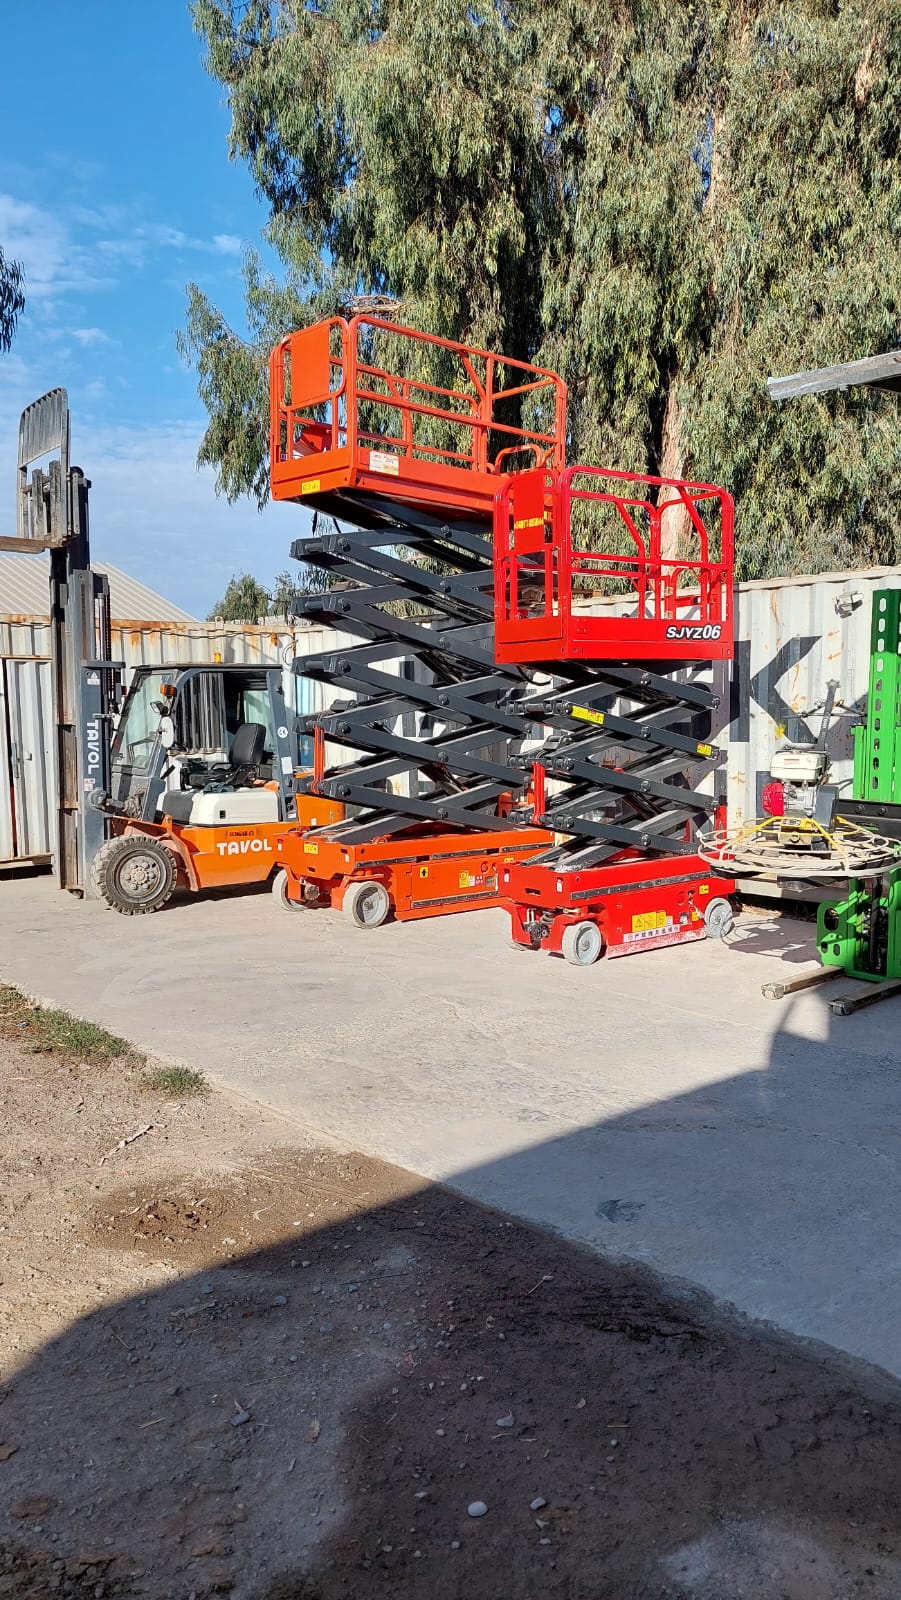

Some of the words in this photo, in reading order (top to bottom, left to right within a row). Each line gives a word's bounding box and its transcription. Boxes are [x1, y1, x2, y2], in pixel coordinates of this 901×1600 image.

[666, 624, 722, 640] SJYZ06
[87, 719, 100, 775] TAVOL
[216, 838, 272, 856] TAVOL
